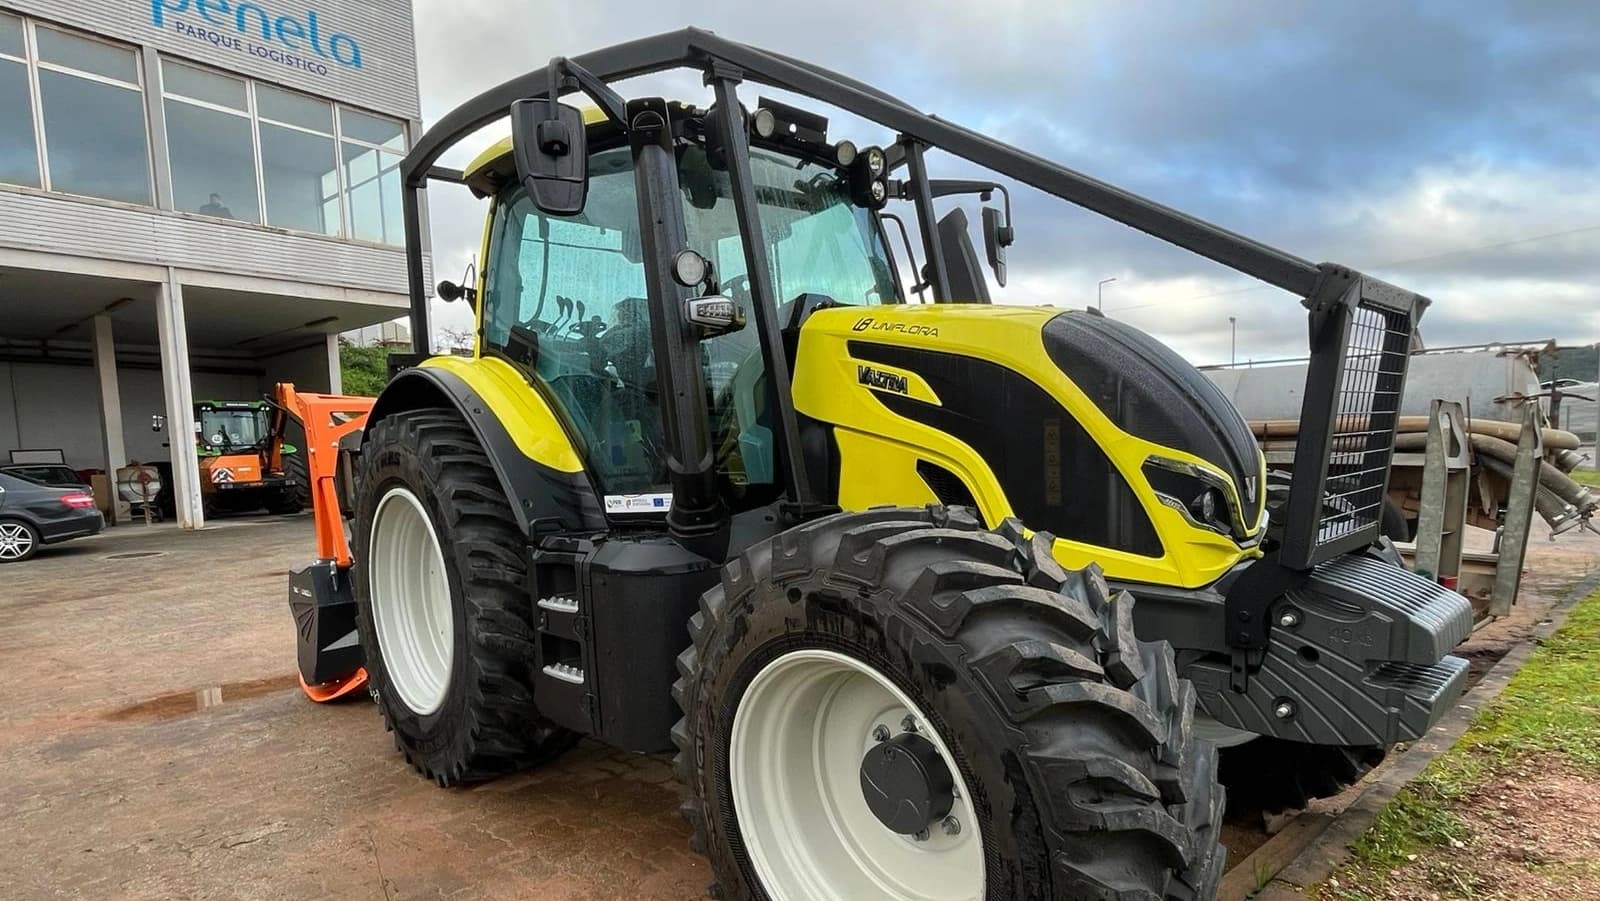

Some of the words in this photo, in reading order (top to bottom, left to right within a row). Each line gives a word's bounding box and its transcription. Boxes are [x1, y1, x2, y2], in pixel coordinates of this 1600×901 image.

[176, 22, 242, 51] PARQUE
[872, 322, 939, 337] UNIFLORA
[858, 365, 908, 394] VALTRA
